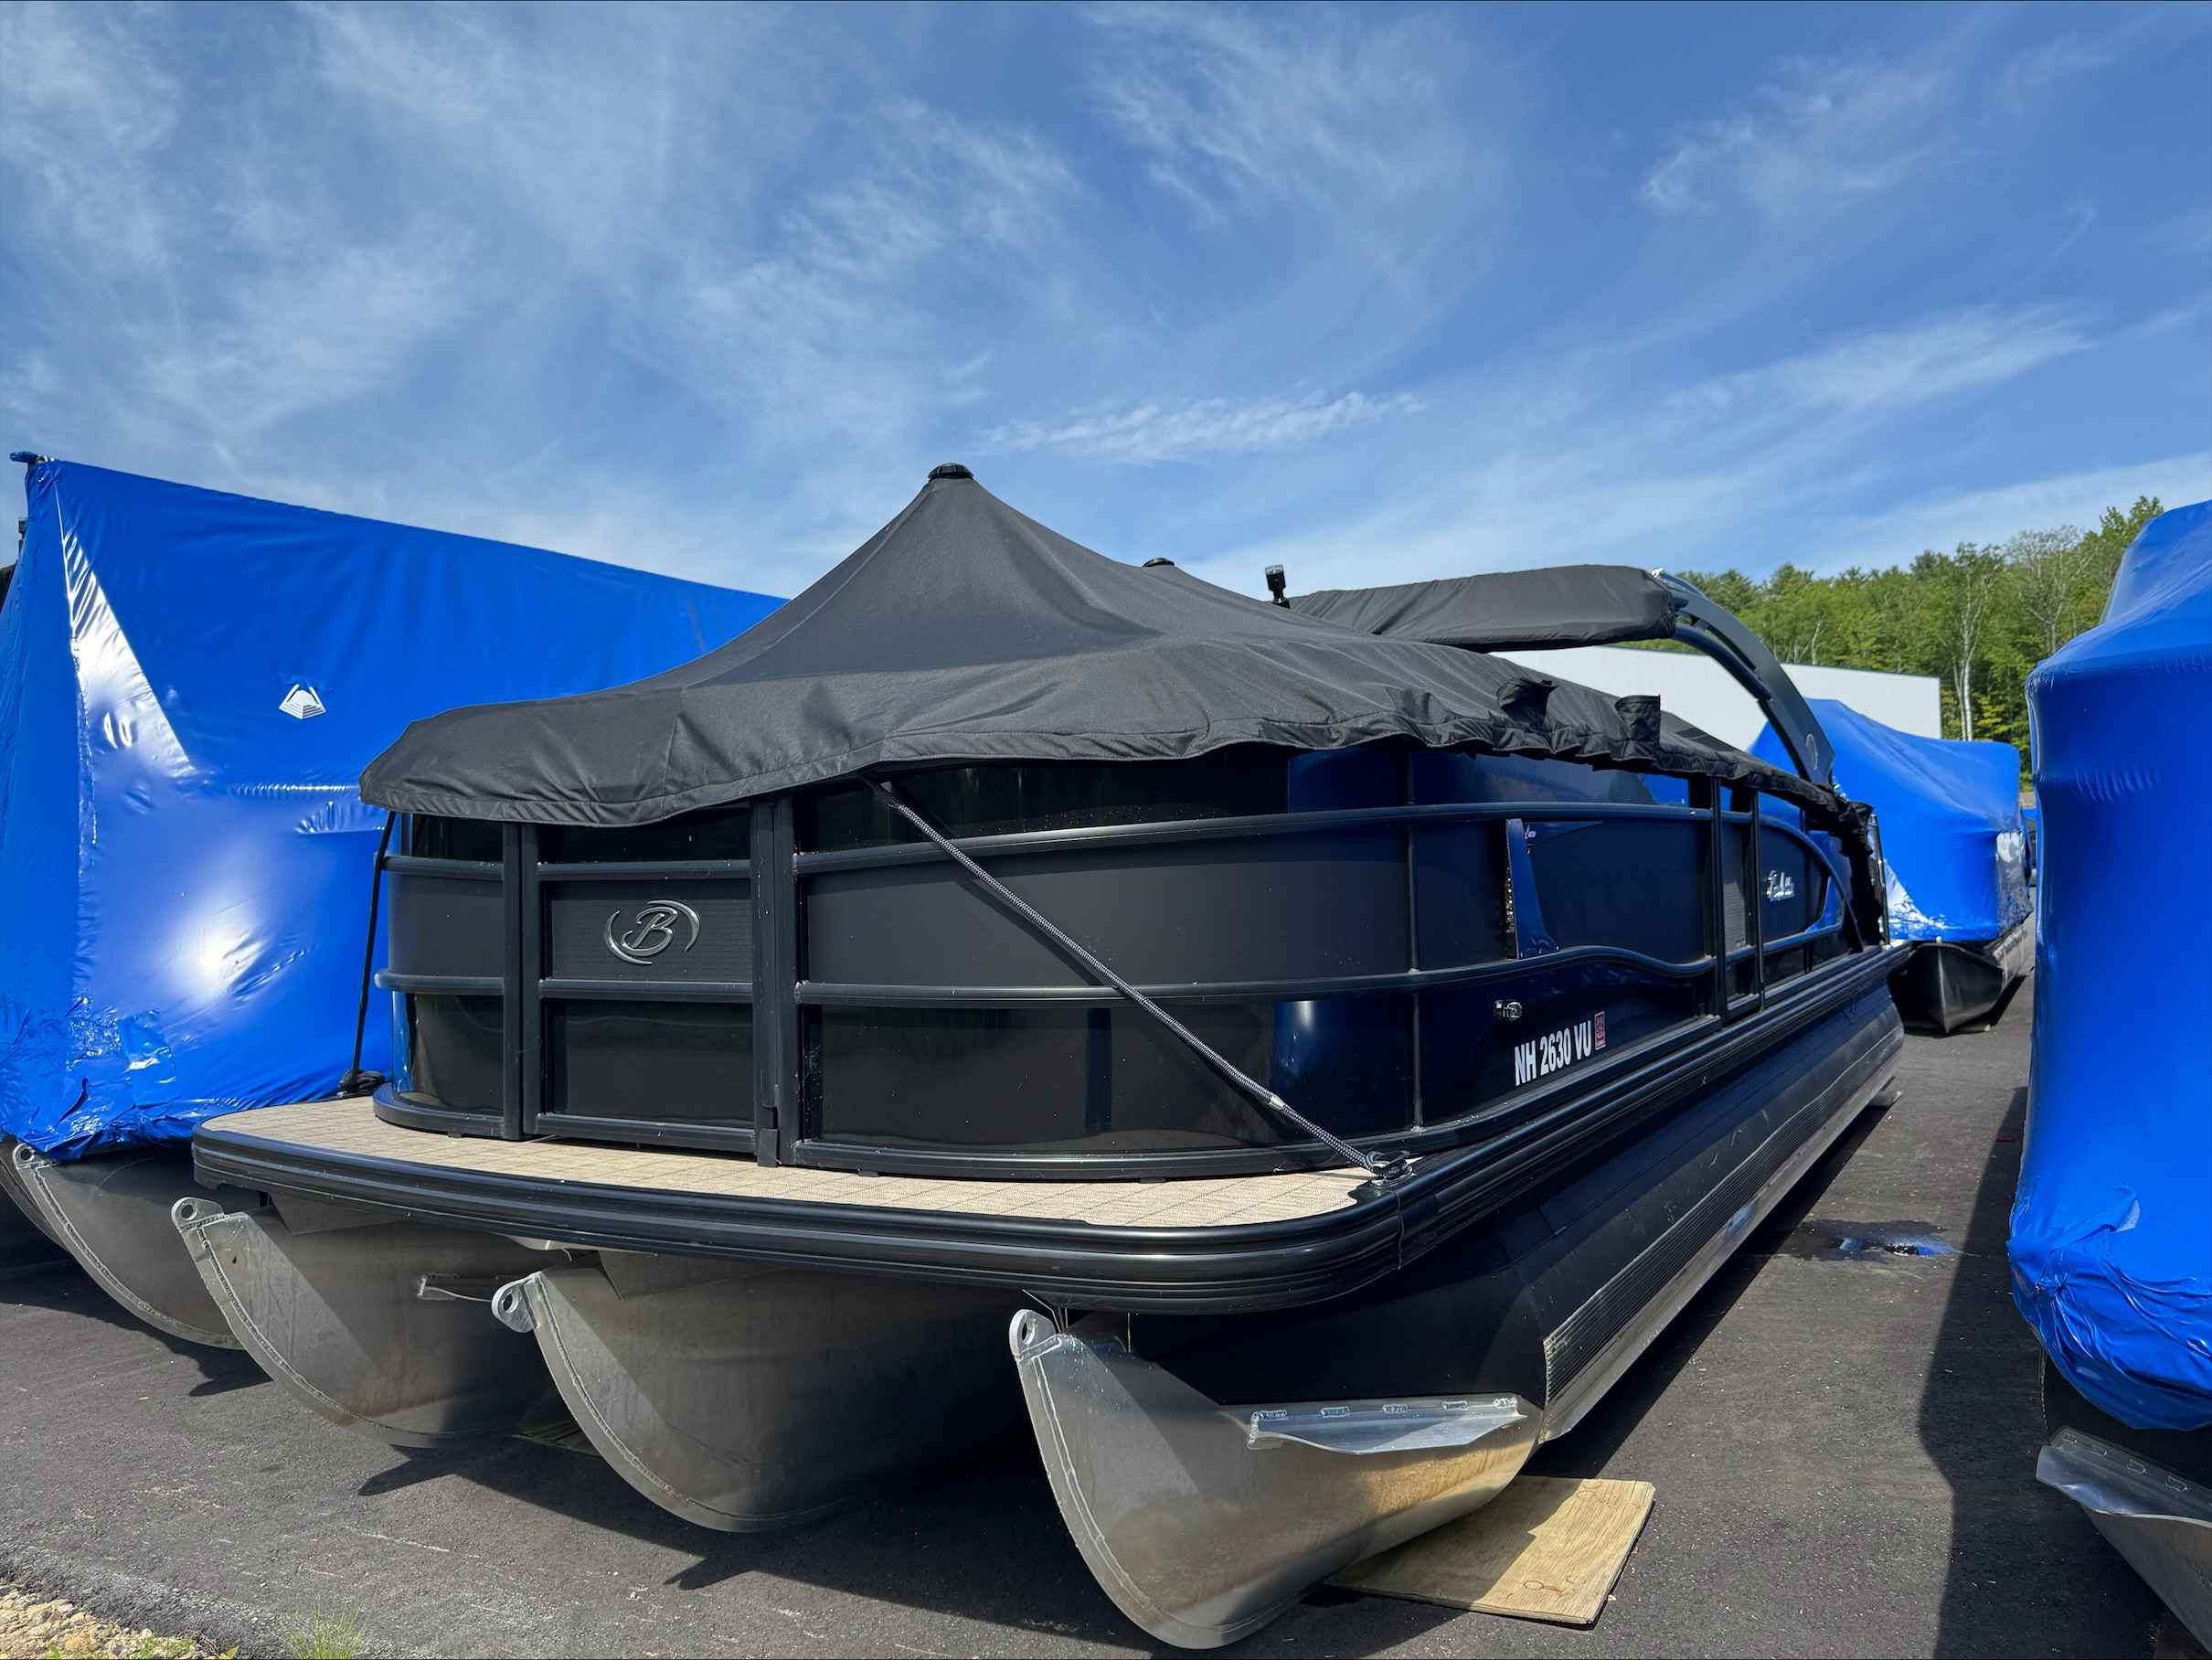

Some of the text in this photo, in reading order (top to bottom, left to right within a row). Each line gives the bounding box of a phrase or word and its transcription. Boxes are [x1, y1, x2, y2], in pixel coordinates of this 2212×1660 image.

[622, 906, 677, 956] B
[1514, 1040, 1537, 1086] NH
[1539, 1027, 1572, 1076] 2630
[1573, 1020, 1592, 1060] VU
